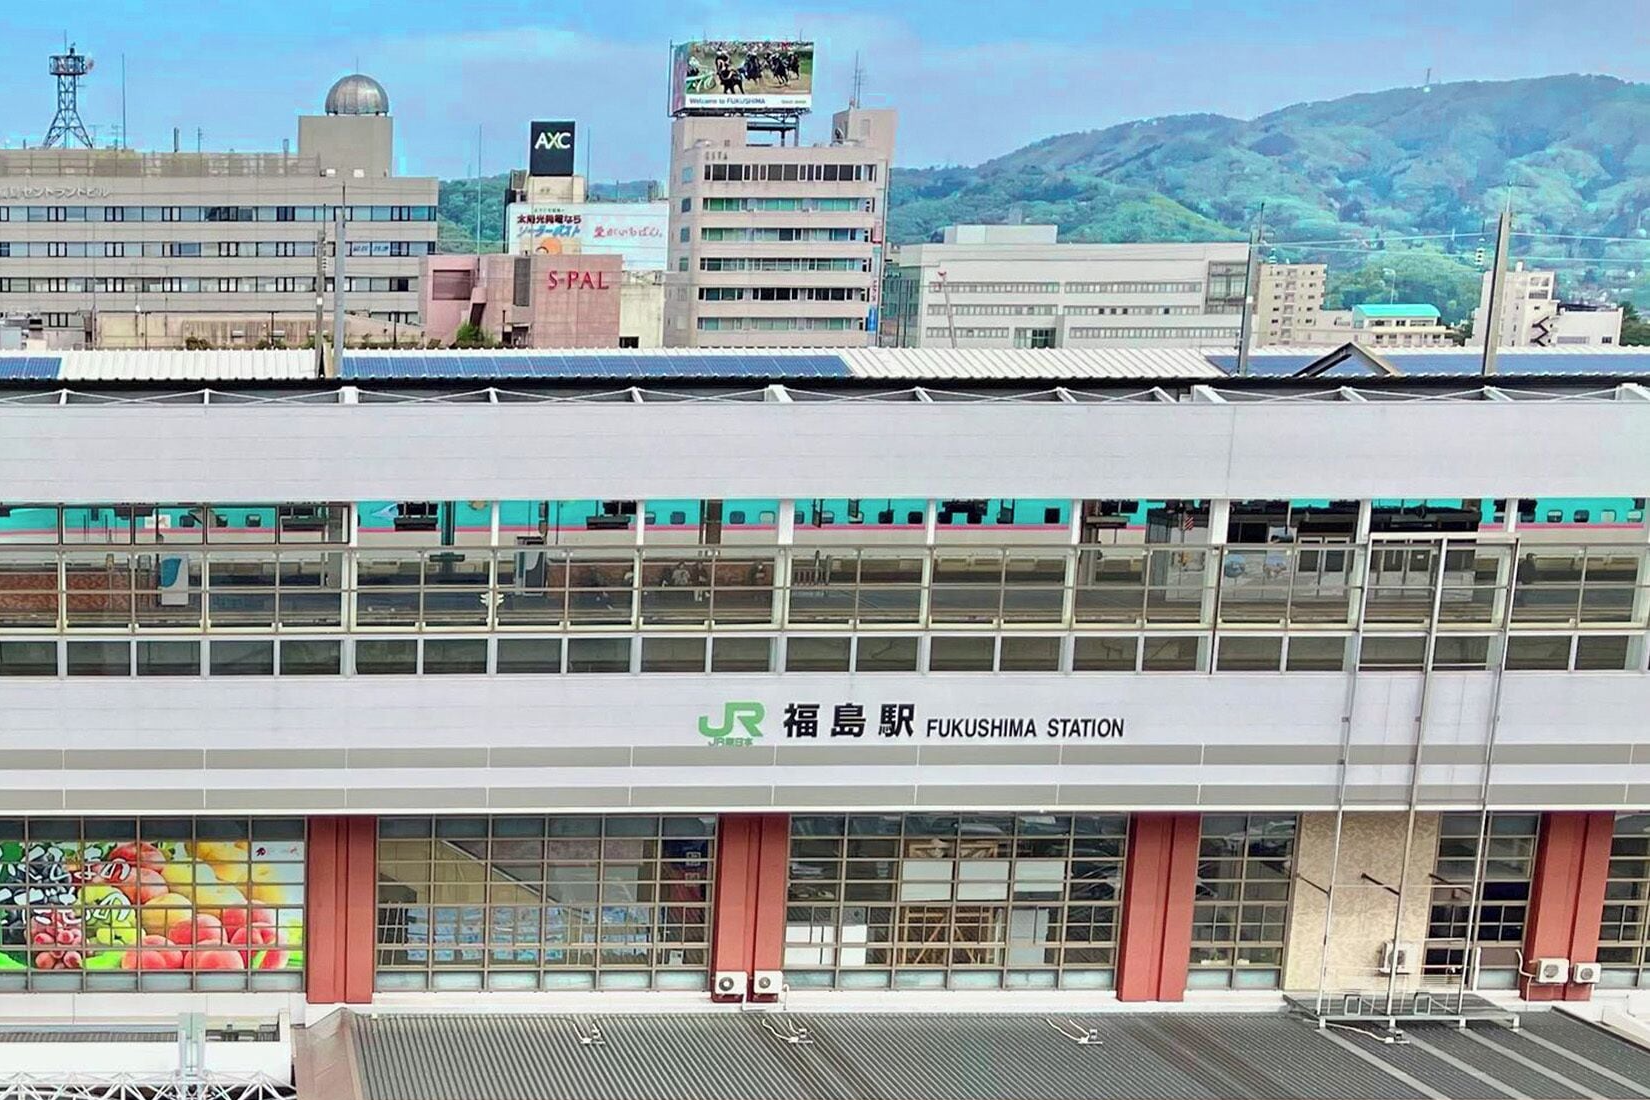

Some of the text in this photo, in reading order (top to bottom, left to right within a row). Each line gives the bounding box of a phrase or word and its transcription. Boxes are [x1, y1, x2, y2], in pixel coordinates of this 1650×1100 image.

[689, 97, 717, 105] Welcome
[727, 97, 766, 105] FUKUSHIMA
[534, 131, 571, 150] AXC
[547, 270, 610, 290] S-PAL
[699, 701, 766, 737] JR
[783, 702, 915, 738] 福島駅
[926, 718, 1125, 738] FUKUSHIMA STATION
